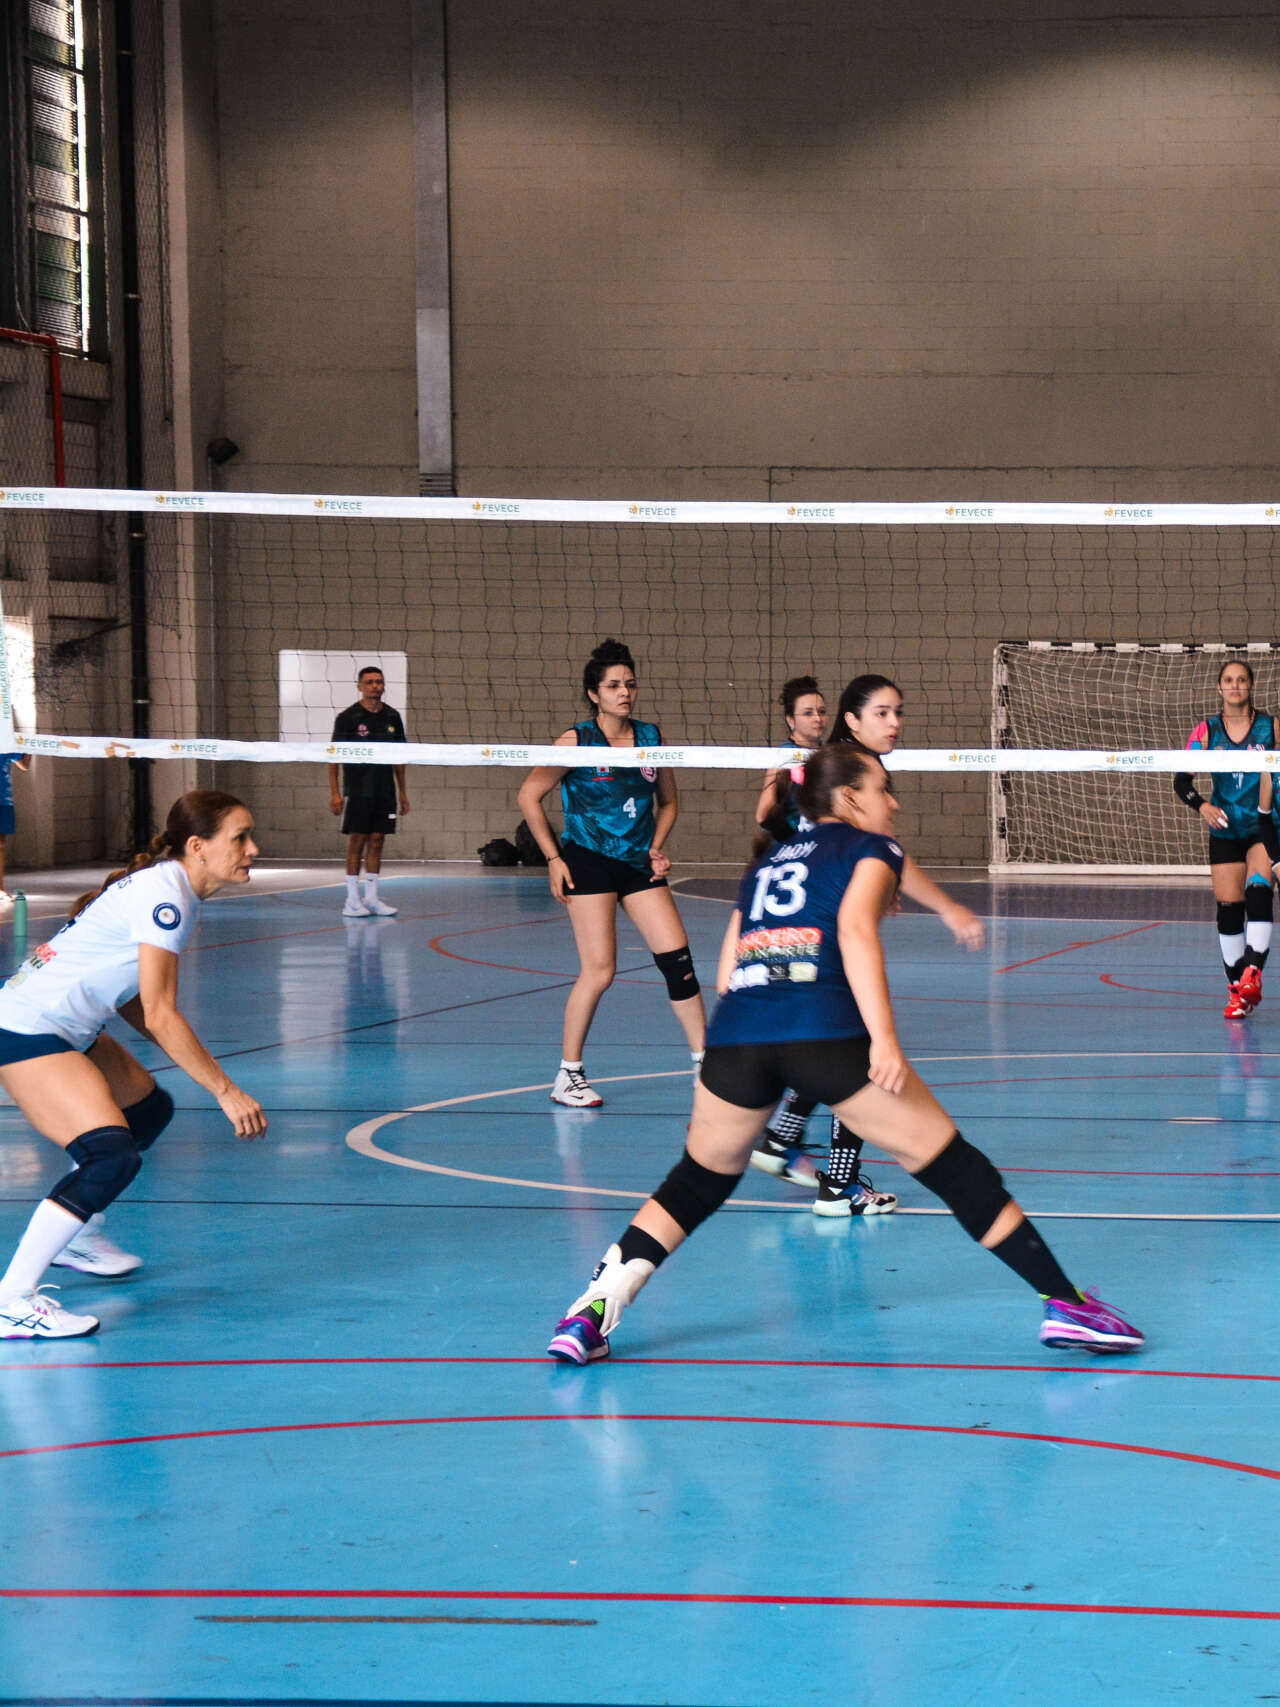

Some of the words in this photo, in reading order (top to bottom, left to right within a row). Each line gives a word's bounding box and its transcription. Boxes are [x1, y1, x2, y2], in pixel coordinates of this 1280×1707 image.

[7, 492, 45, 502] FEVECE
[166, 496, 205, 505] FEVECE
[325, 500, 362, 510] FEVECE
[483, 503, 520, 513] FEVECE
[639, 507, 676, 516] FEVECE
[797, 508, 835, 517] FEVECE
[956, 508, 993, 517] FEVECE
[1114, 508, 1153, 518] FEVECE
[181, 744, 217, 754] FEVECE
[337, 747, 373, 757] FEVECE
[490, 749, 529, 759] FEVECE
[646, 751, 684, 761] FEVECE
[959, 754, 997, 763] FEVECE
[1116, 755, 1154, 765] FEVECE
[622, 796, 637, 819] 4
[749, 861, 809, 922] 13
